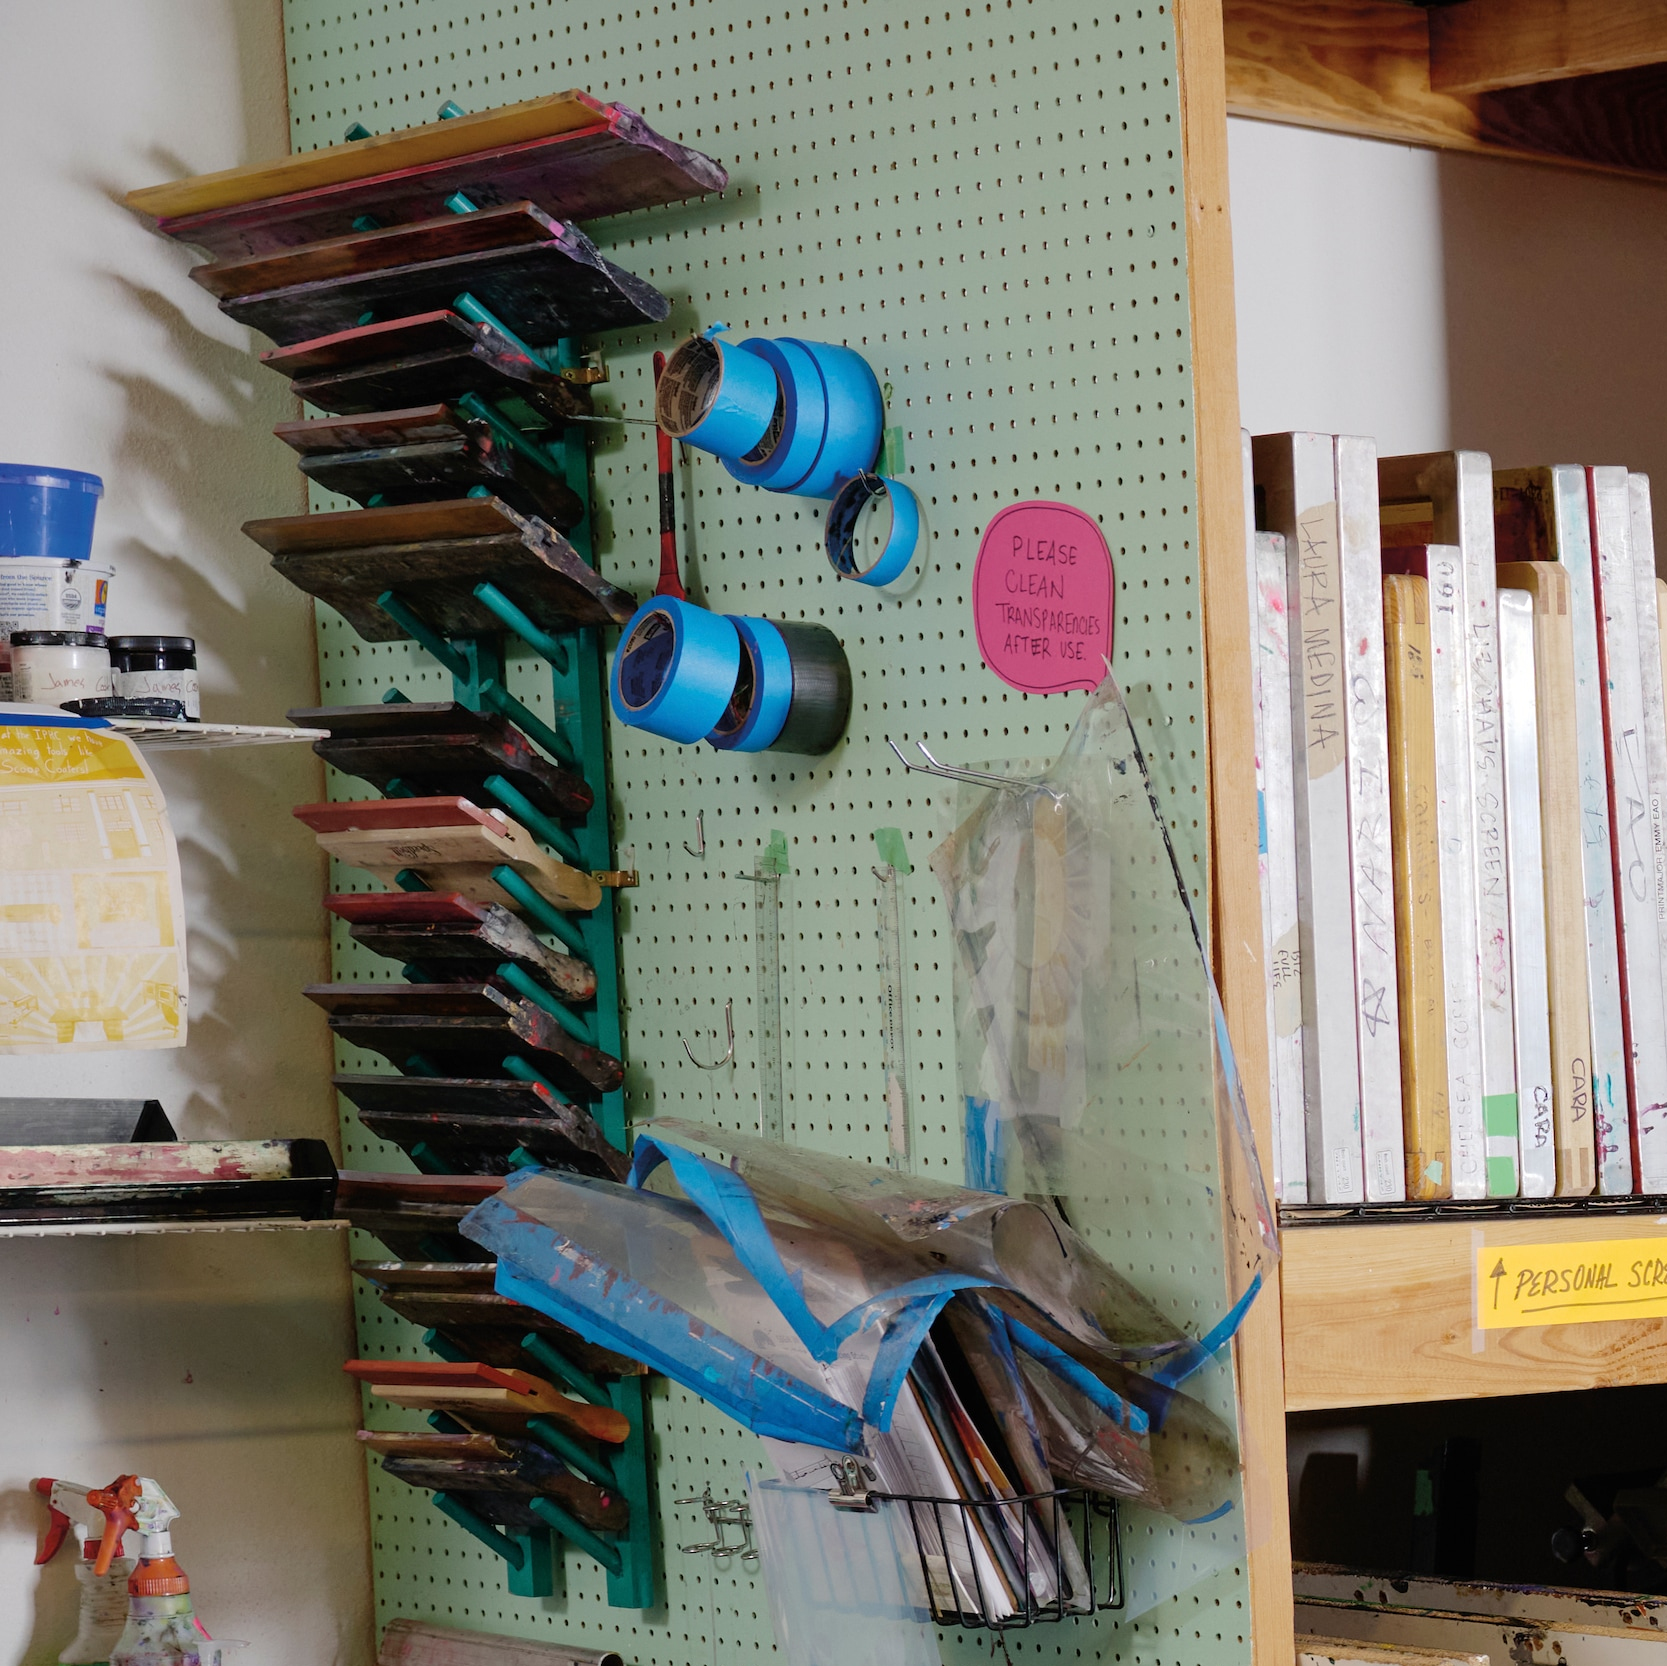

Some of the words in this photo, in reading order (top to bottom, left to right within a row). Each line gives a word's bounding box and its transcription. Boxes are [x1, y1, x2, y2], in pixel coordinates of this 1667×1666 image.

[1013, 535, 1078, 566] PLEASE
[1299, 518, 1336, 617] LAURA
[1005, 569, 1064, 599] CLEAN
[995, 602, 1101, 635] TRANSPARENCIES
[1004, 633, 1052, 660] AFTER
[1060, 641, 1086, 661] USE.
[1303, 628, 1340, 749] MEDINA
[1651, 797, 1660, 819] EAO
[1657, 856, 1667, 920] PRINTMAJOR
[1570, 1057, 1590, 1124] CARA
[1532, 1085, 1551, 1149] CARA
[1513, 1262, 1618, 1301] PERSONAL
